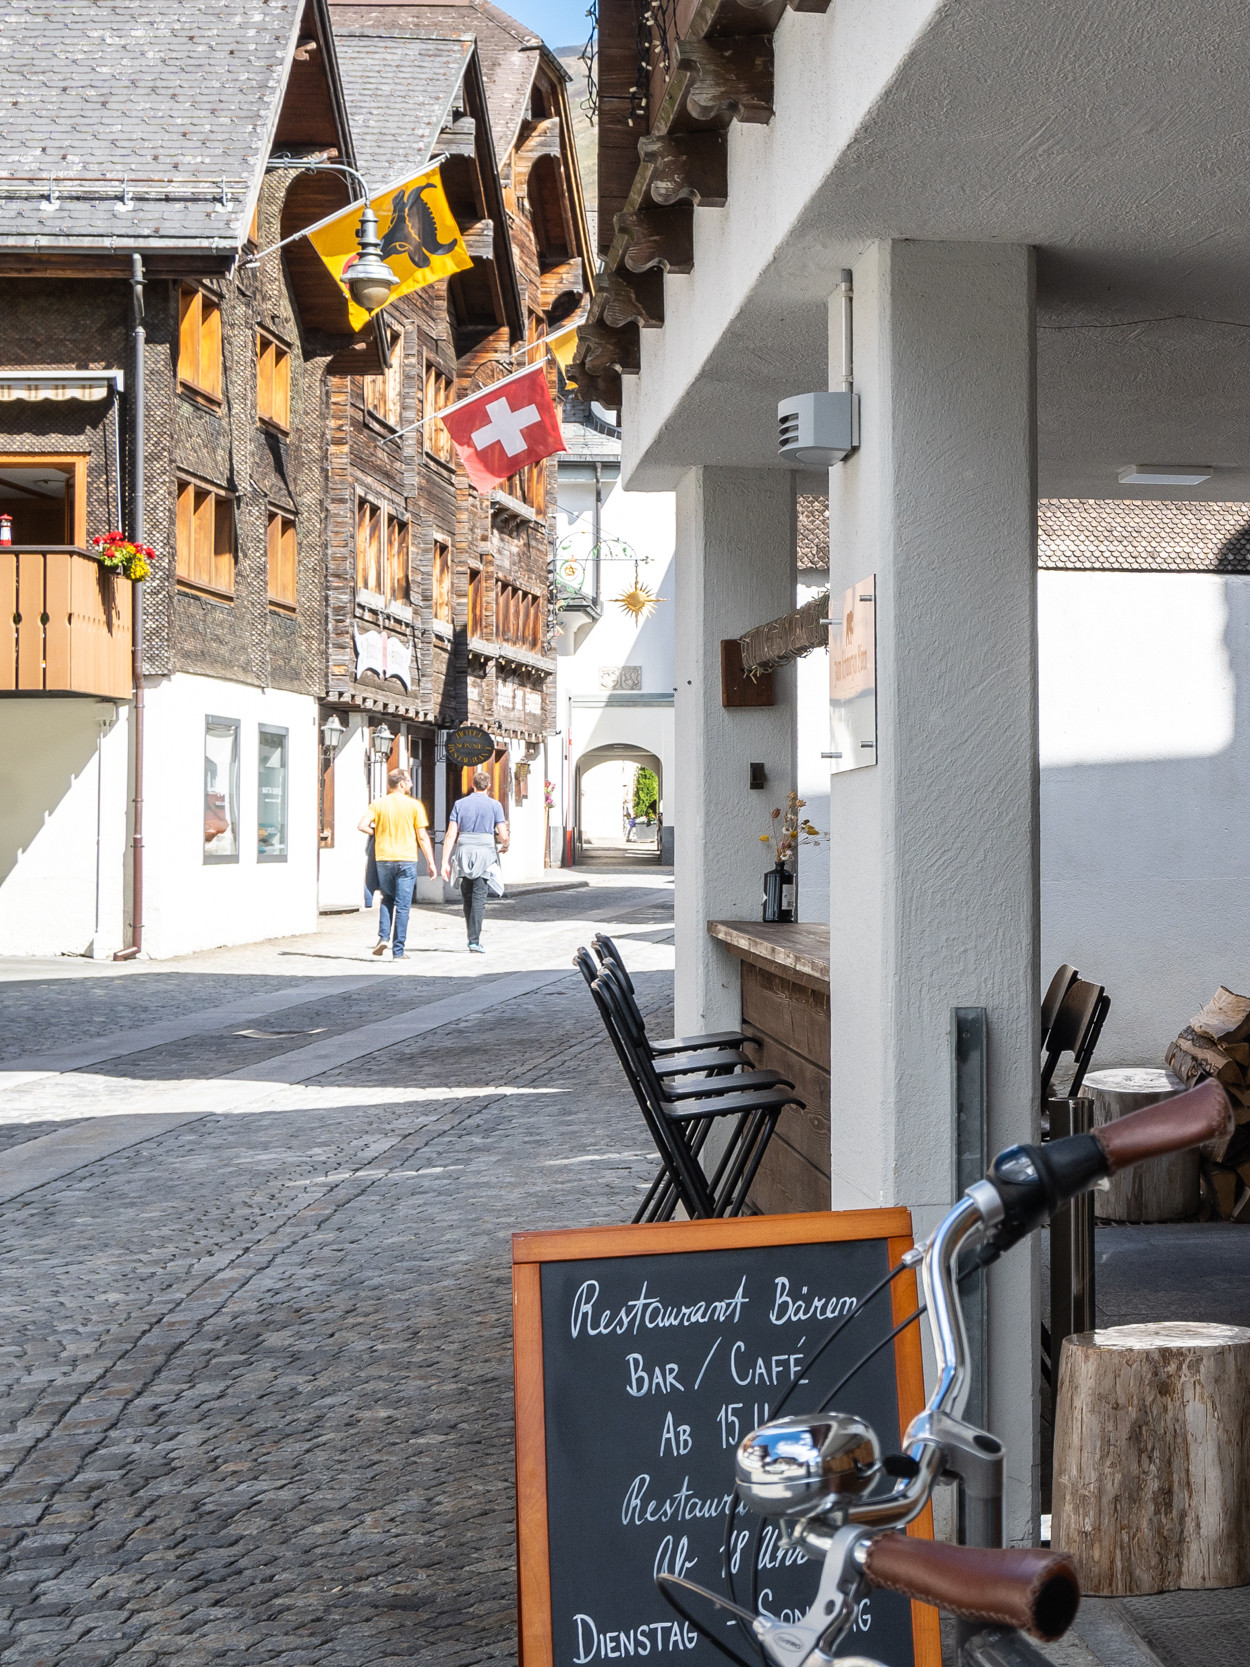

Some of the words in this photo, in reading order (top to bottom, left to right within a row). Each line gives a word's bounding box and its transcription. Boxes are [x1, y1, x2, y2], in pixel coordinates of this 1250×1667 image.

[571, 1275, 749, 1339] Restaurant
[770, 1276, 864, 1325] Bären
[694, 1336, 723, 1390] /
[717, 1402, 744, 1449] 15
